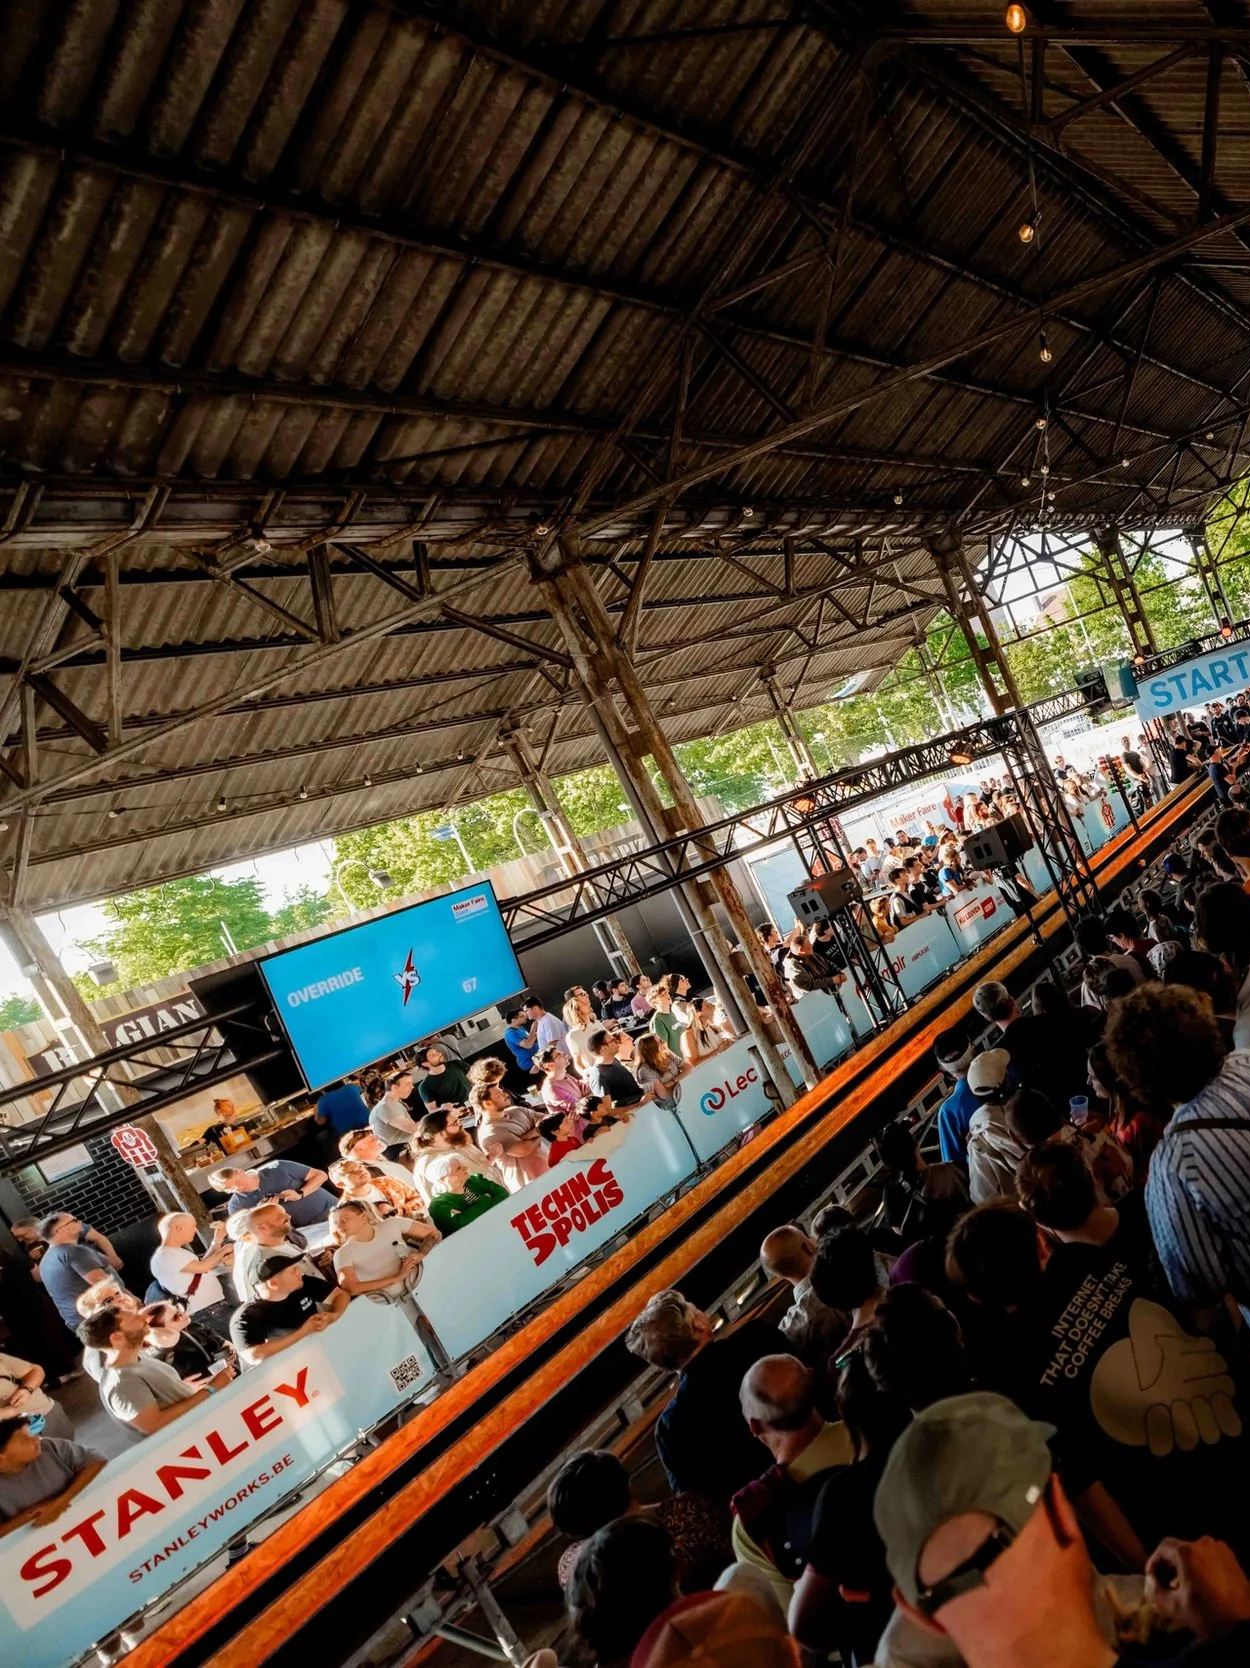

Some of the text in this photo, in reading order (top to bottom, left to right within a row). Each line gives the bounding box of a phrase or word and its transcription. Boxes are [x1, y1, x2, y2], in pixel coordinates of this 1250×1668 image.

[1150, 651, 1248, 708] START
[917, 802, 938, 817] Faire
[287, 967, 364, 1008] OVERRIDE
[393, 970, 421, 988] VS
[462, 976, 477, 993] 67
[724, 1067, 758, 1098] Lec
[1040, 1262, 1127, 1386] THAT DOESN'T TAKE
[1051, 1274, 1098, 1339] INTERNET
[1064, 1277, 1132, 1378] COFFEE BREAKS
[128, 1453, 294, 1584] STANLEYWORKS.BE
